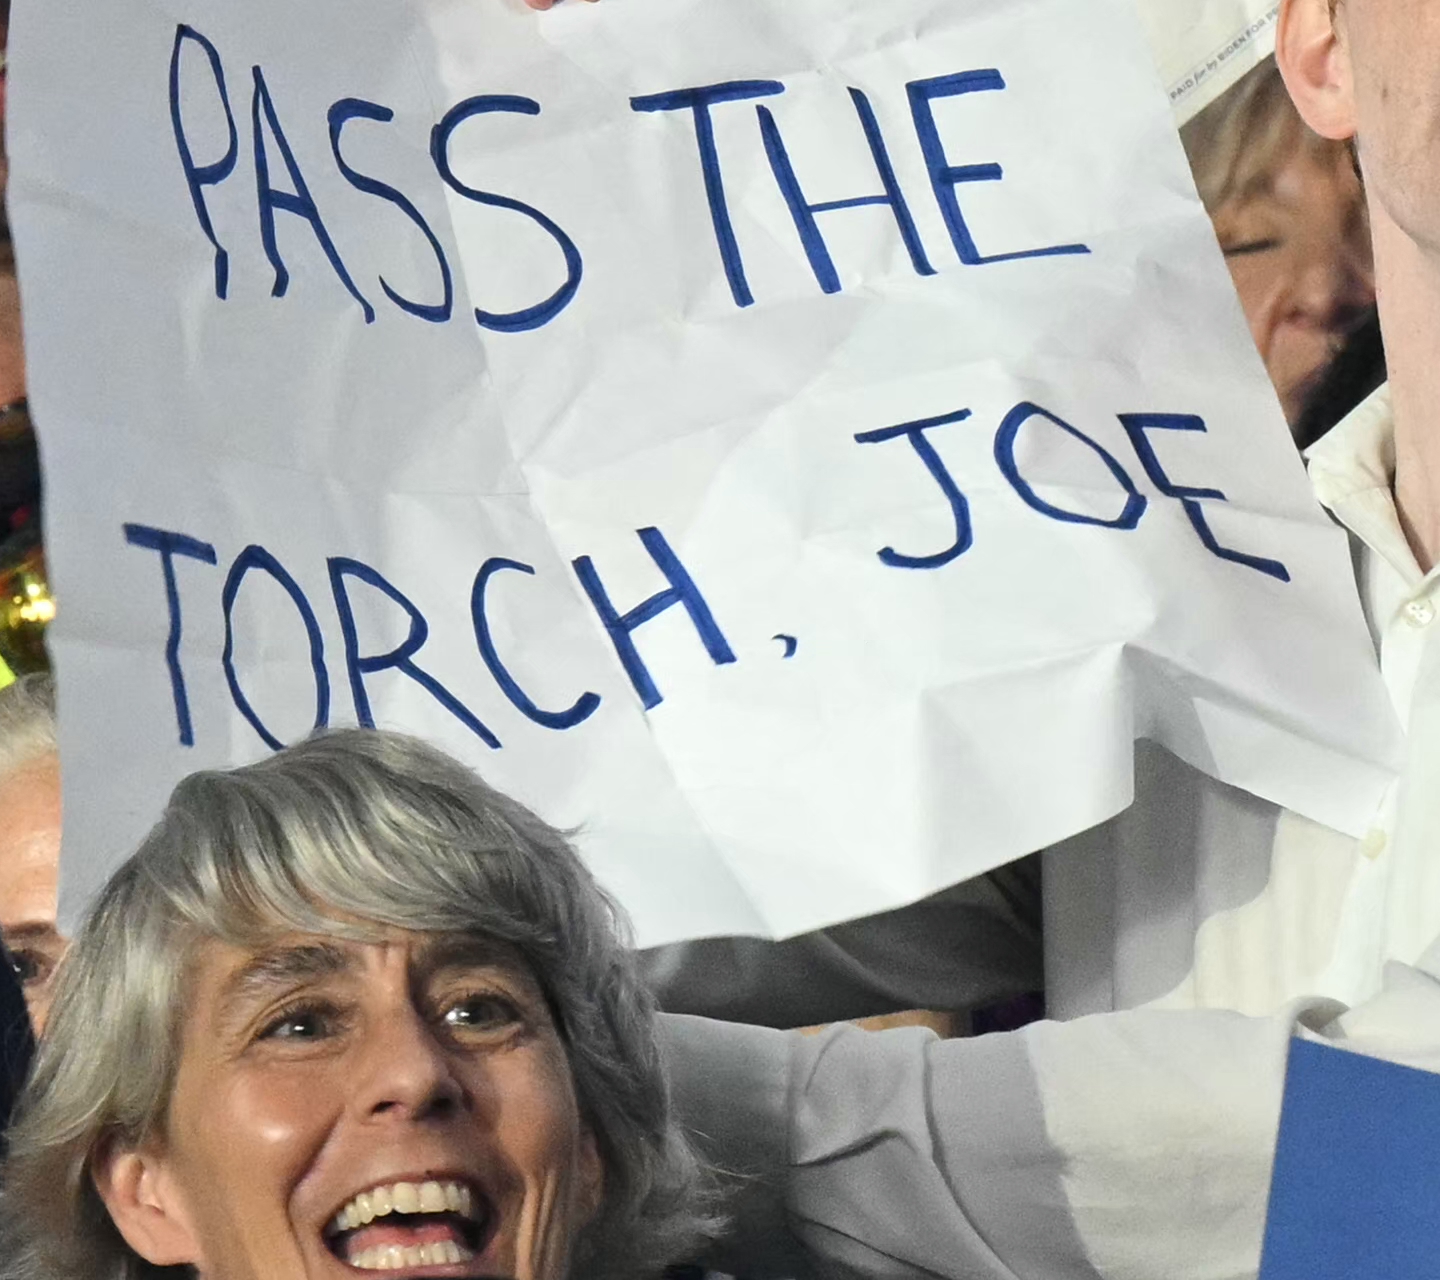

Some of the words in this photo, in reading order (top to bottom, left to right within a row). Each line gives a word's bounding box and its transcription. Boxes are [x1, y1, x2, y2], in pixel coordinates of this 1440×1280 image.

[1216, 34, 1248, 63] BIDEN
[169, 23, 582, 332] PASS
[630, 67, 1091, 308] THE
[853, 399, 1291, 582] JOE
